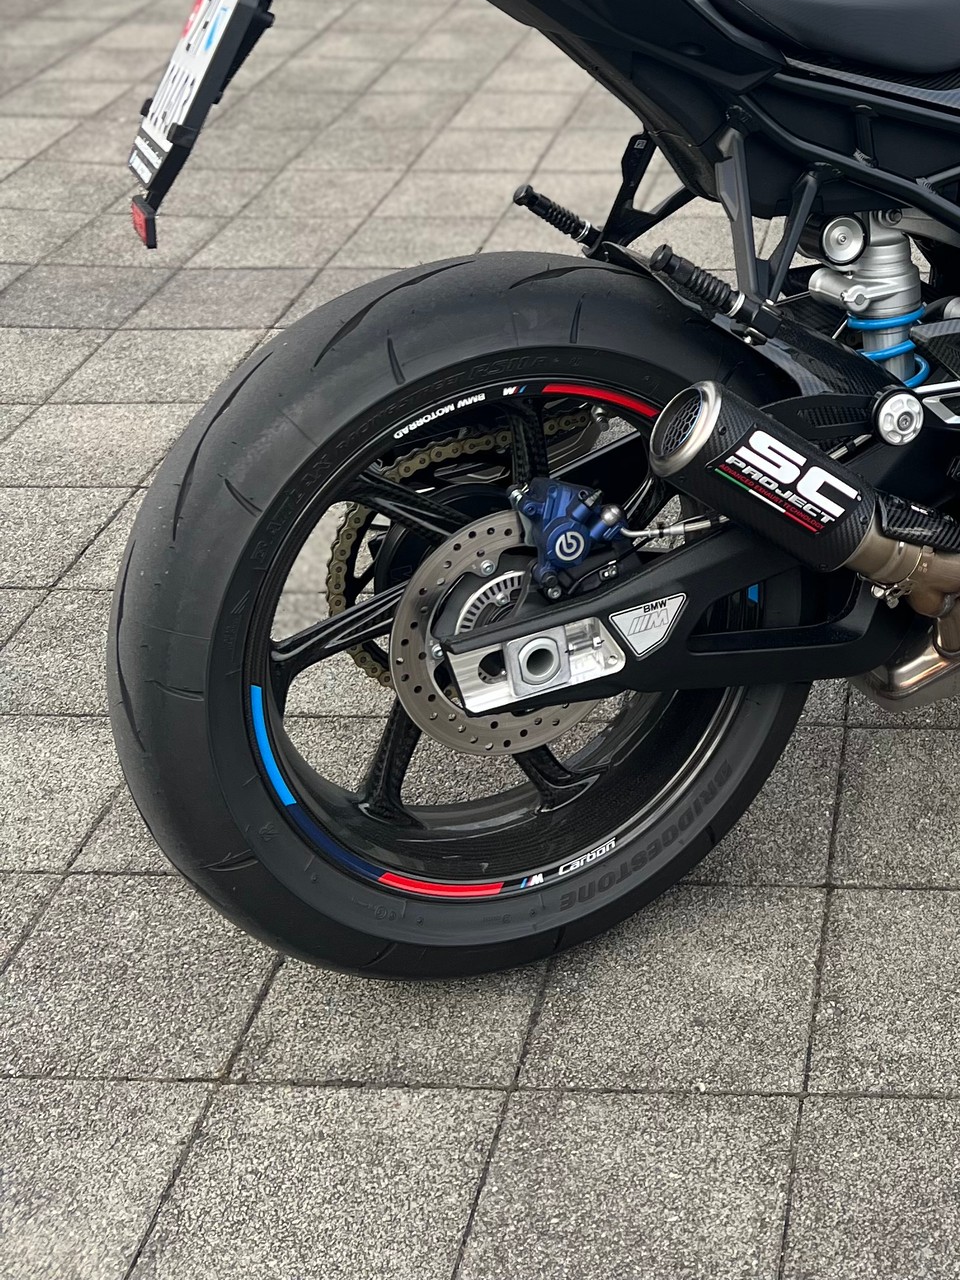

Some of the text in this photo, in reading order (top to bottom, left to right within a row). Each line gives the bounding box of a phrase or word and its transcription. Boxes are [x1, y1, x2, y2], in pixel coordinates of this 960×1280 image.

[393, 403, 455, 439] MOTORRAD
[457, 392, 486, 408] BMW
[719, 463, 825, 530] ADVANCED EXHAUST TECHNOLOGY
[725, 455, 836, 524] PROJECT
[735, 430, 859, 518] SC
[643, 600, 667, 613] BMW
[558, 837, 617, 876] Carbon
[559, 759, 733, 912] BRIDGESTONE
